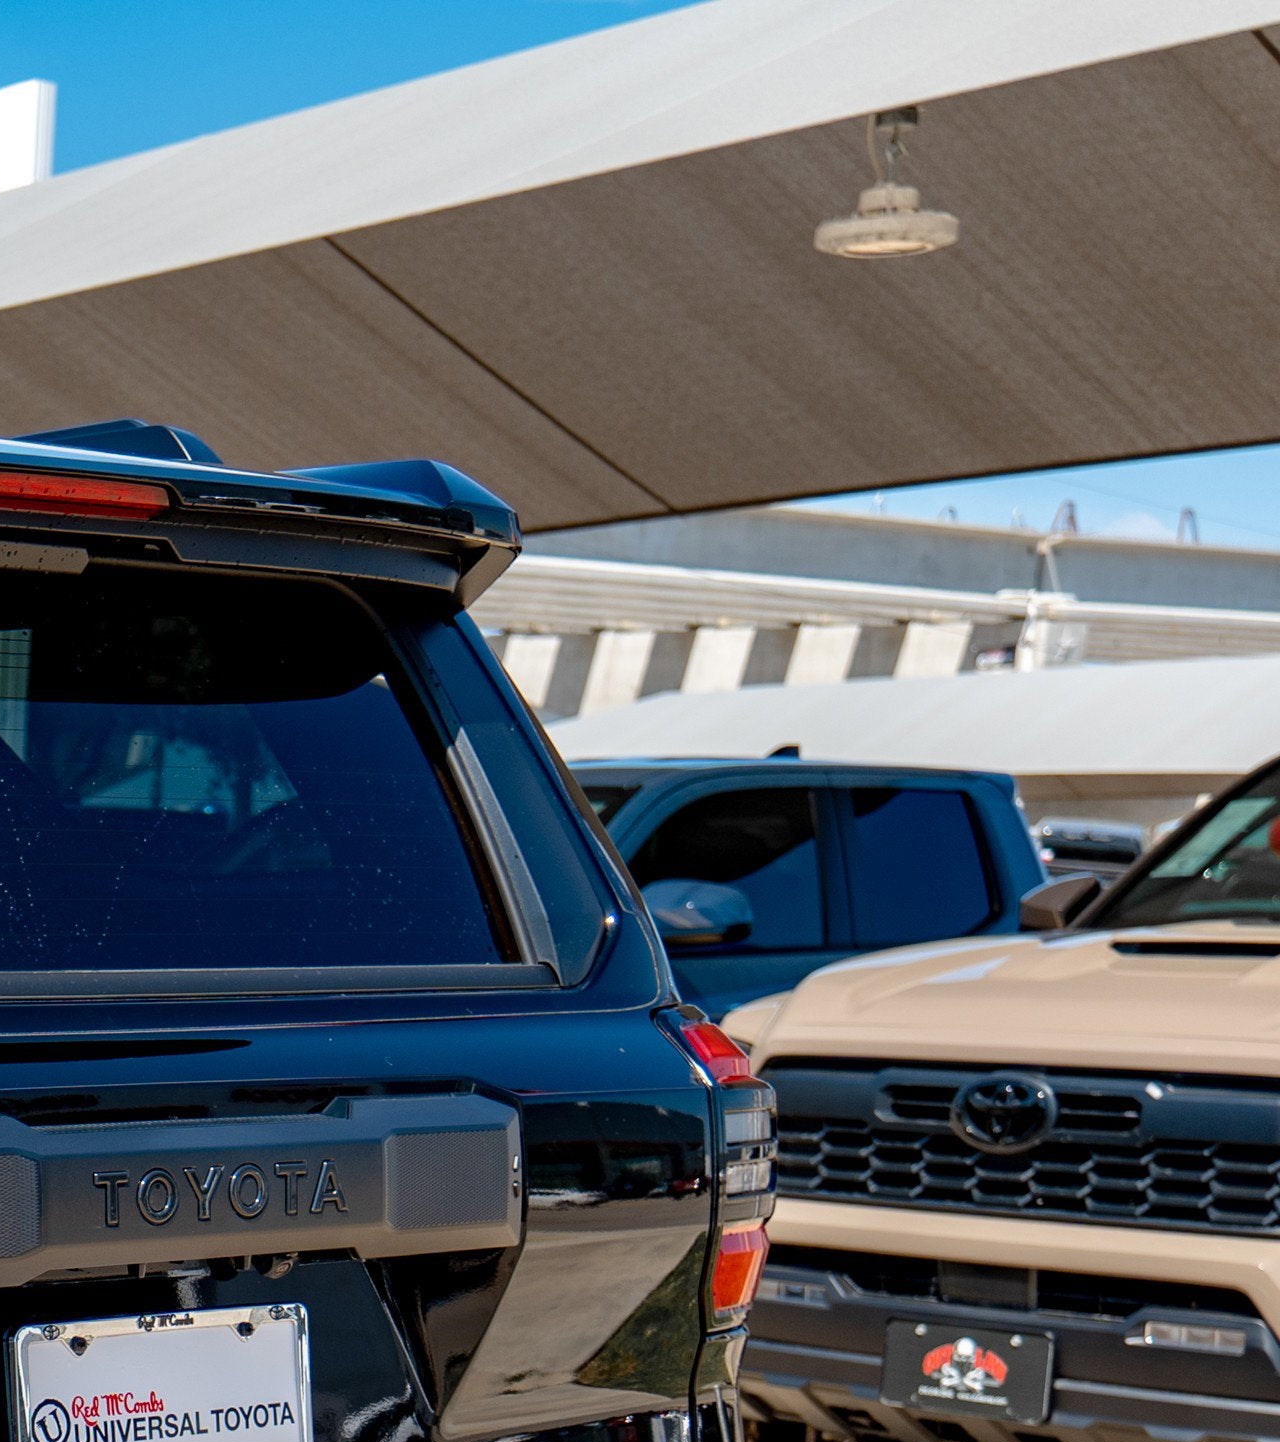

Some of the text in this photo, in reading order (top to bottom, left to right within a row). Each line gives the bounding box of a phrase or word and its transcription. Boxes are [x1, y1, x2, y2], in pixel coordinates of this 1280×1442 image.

[92, 1157, 349, 1228] TOYOTA
[71, 1390, 164, 1428] Red McCombs
[210, 1401, 295, 1433] TOYOTA
